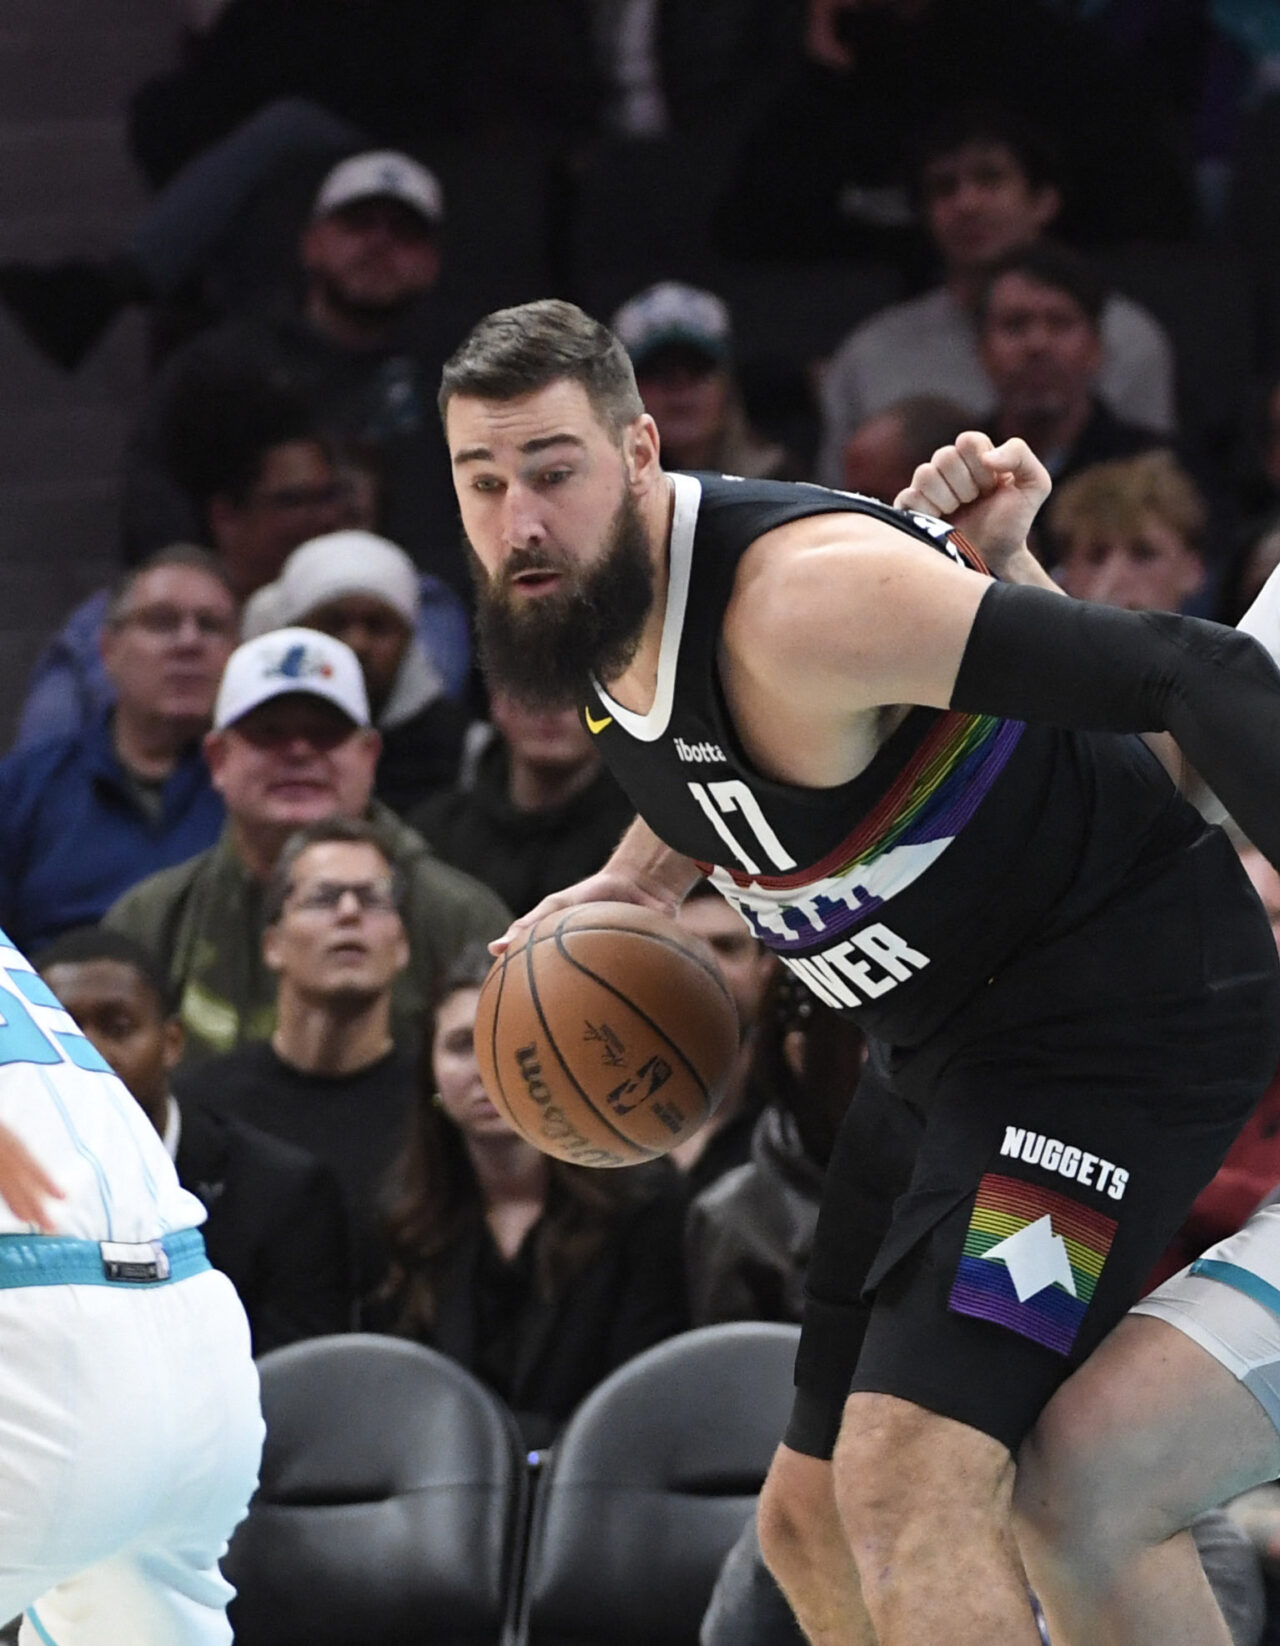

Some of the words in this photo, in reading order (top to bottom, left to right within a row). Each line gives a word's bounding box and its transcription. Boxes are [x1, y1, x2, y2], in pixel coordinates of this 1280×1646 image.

[673, 737, 727, 763] ibotta
[687, 779, 798, 875] 17
[1000, 1125, 1130, 1201] NUGGETS
